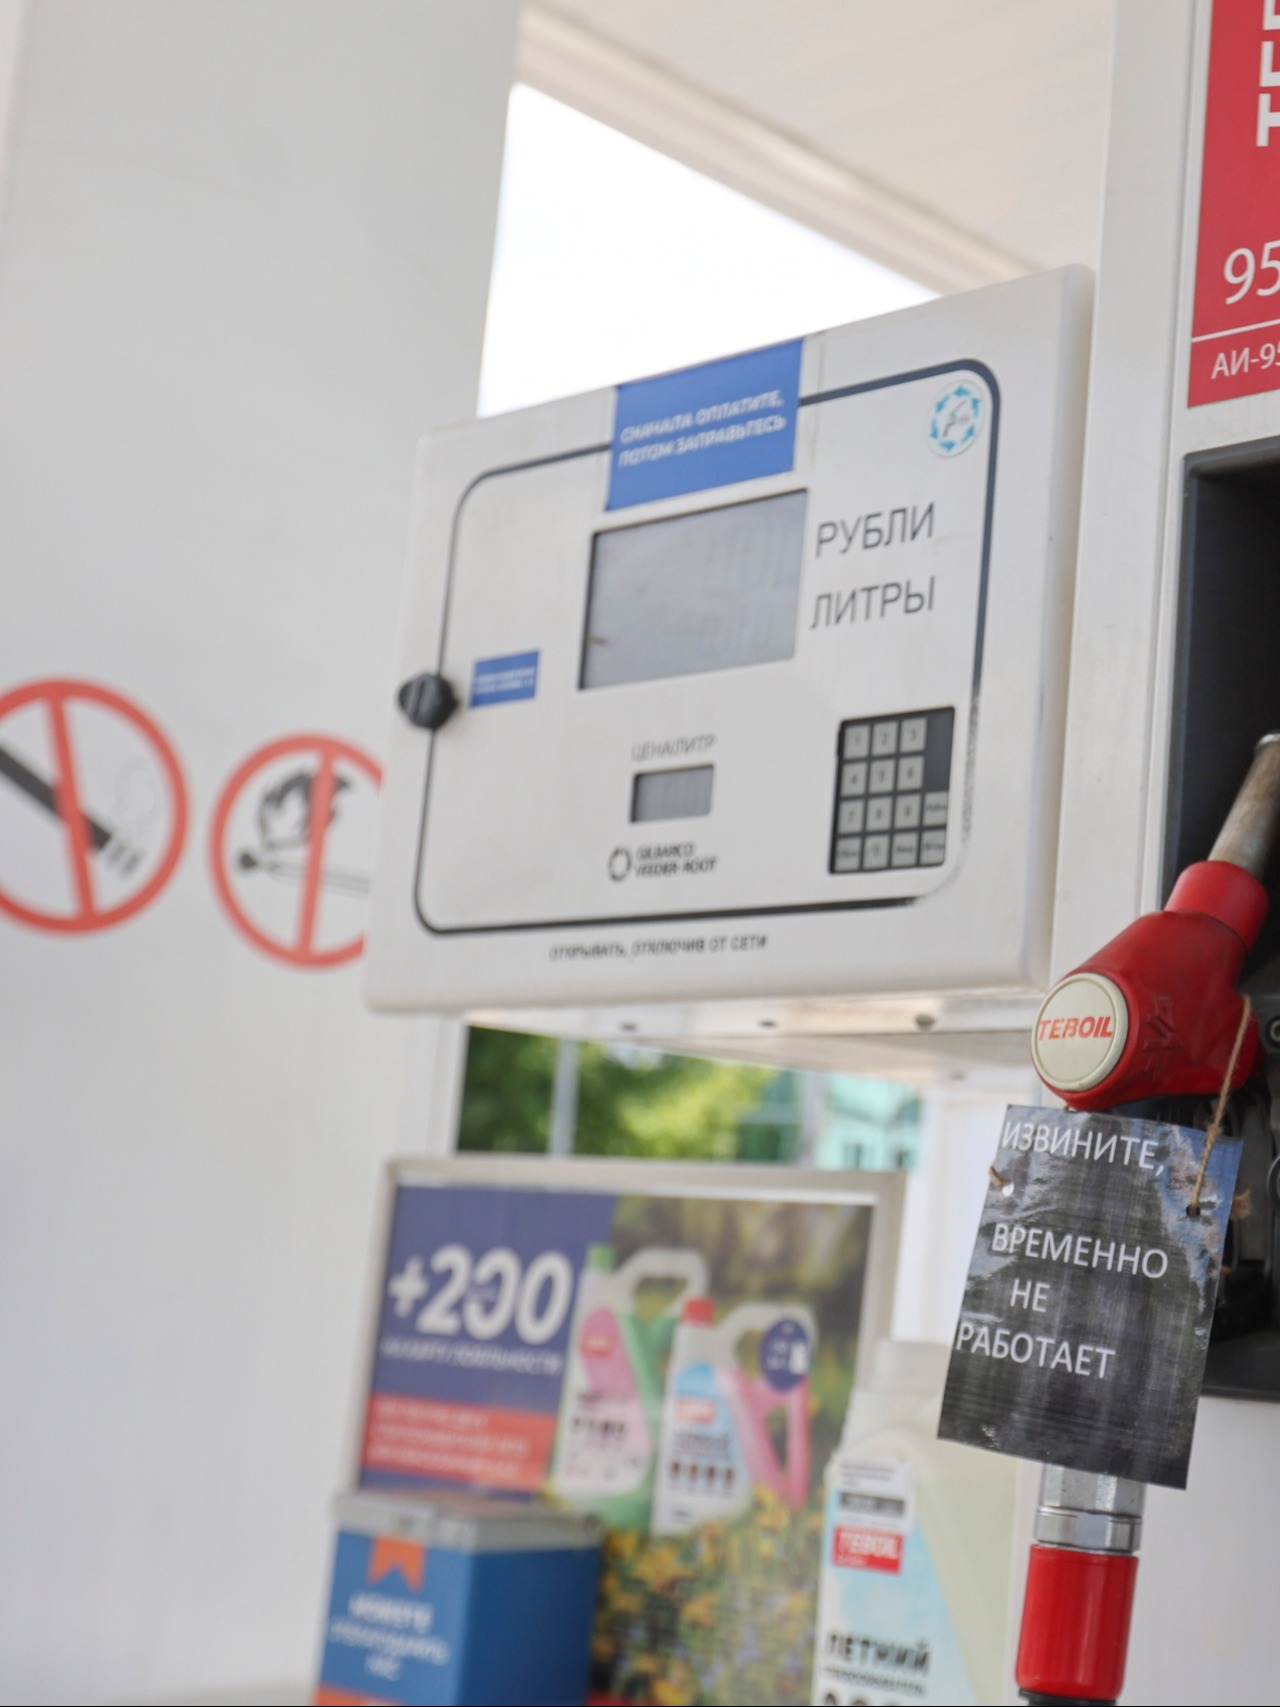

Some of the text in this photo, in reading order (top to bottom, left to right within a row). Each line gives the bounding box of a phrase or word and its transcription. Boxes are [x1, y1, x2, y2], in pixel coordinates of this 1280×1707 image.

[618, 414, 787, 467] ПОТОМ ЗАПРАВЬТЕСЬ
[620, 411, 694, 445] СНАЧАЛА
[815, 502, 935, 559] РУБЛИ
[809, 576, 936, 629] ЛИТРЫ
[630, 937, 706, 958] ОТКЛЮЧИВ
[708, 935, 727, 953] ОТ
[729, 933, 769, 951] СЕТИ
[1038, 1015, 1114, 1041] TEBOIL
[1000, 1121, 1165, 1177] ИЗВИНИТЕ,
[991, 1222, 1169, 1279] ВРЕМЕННО
[1010, 1277, 1051, 1313] НЕ
[955, 1320, 1116, 1379] РАБОТАЕТ
[839, 1531, 900, 1560] TEBOIL
[827, 1634, 930, 1676] ЛЕТНИЙ
